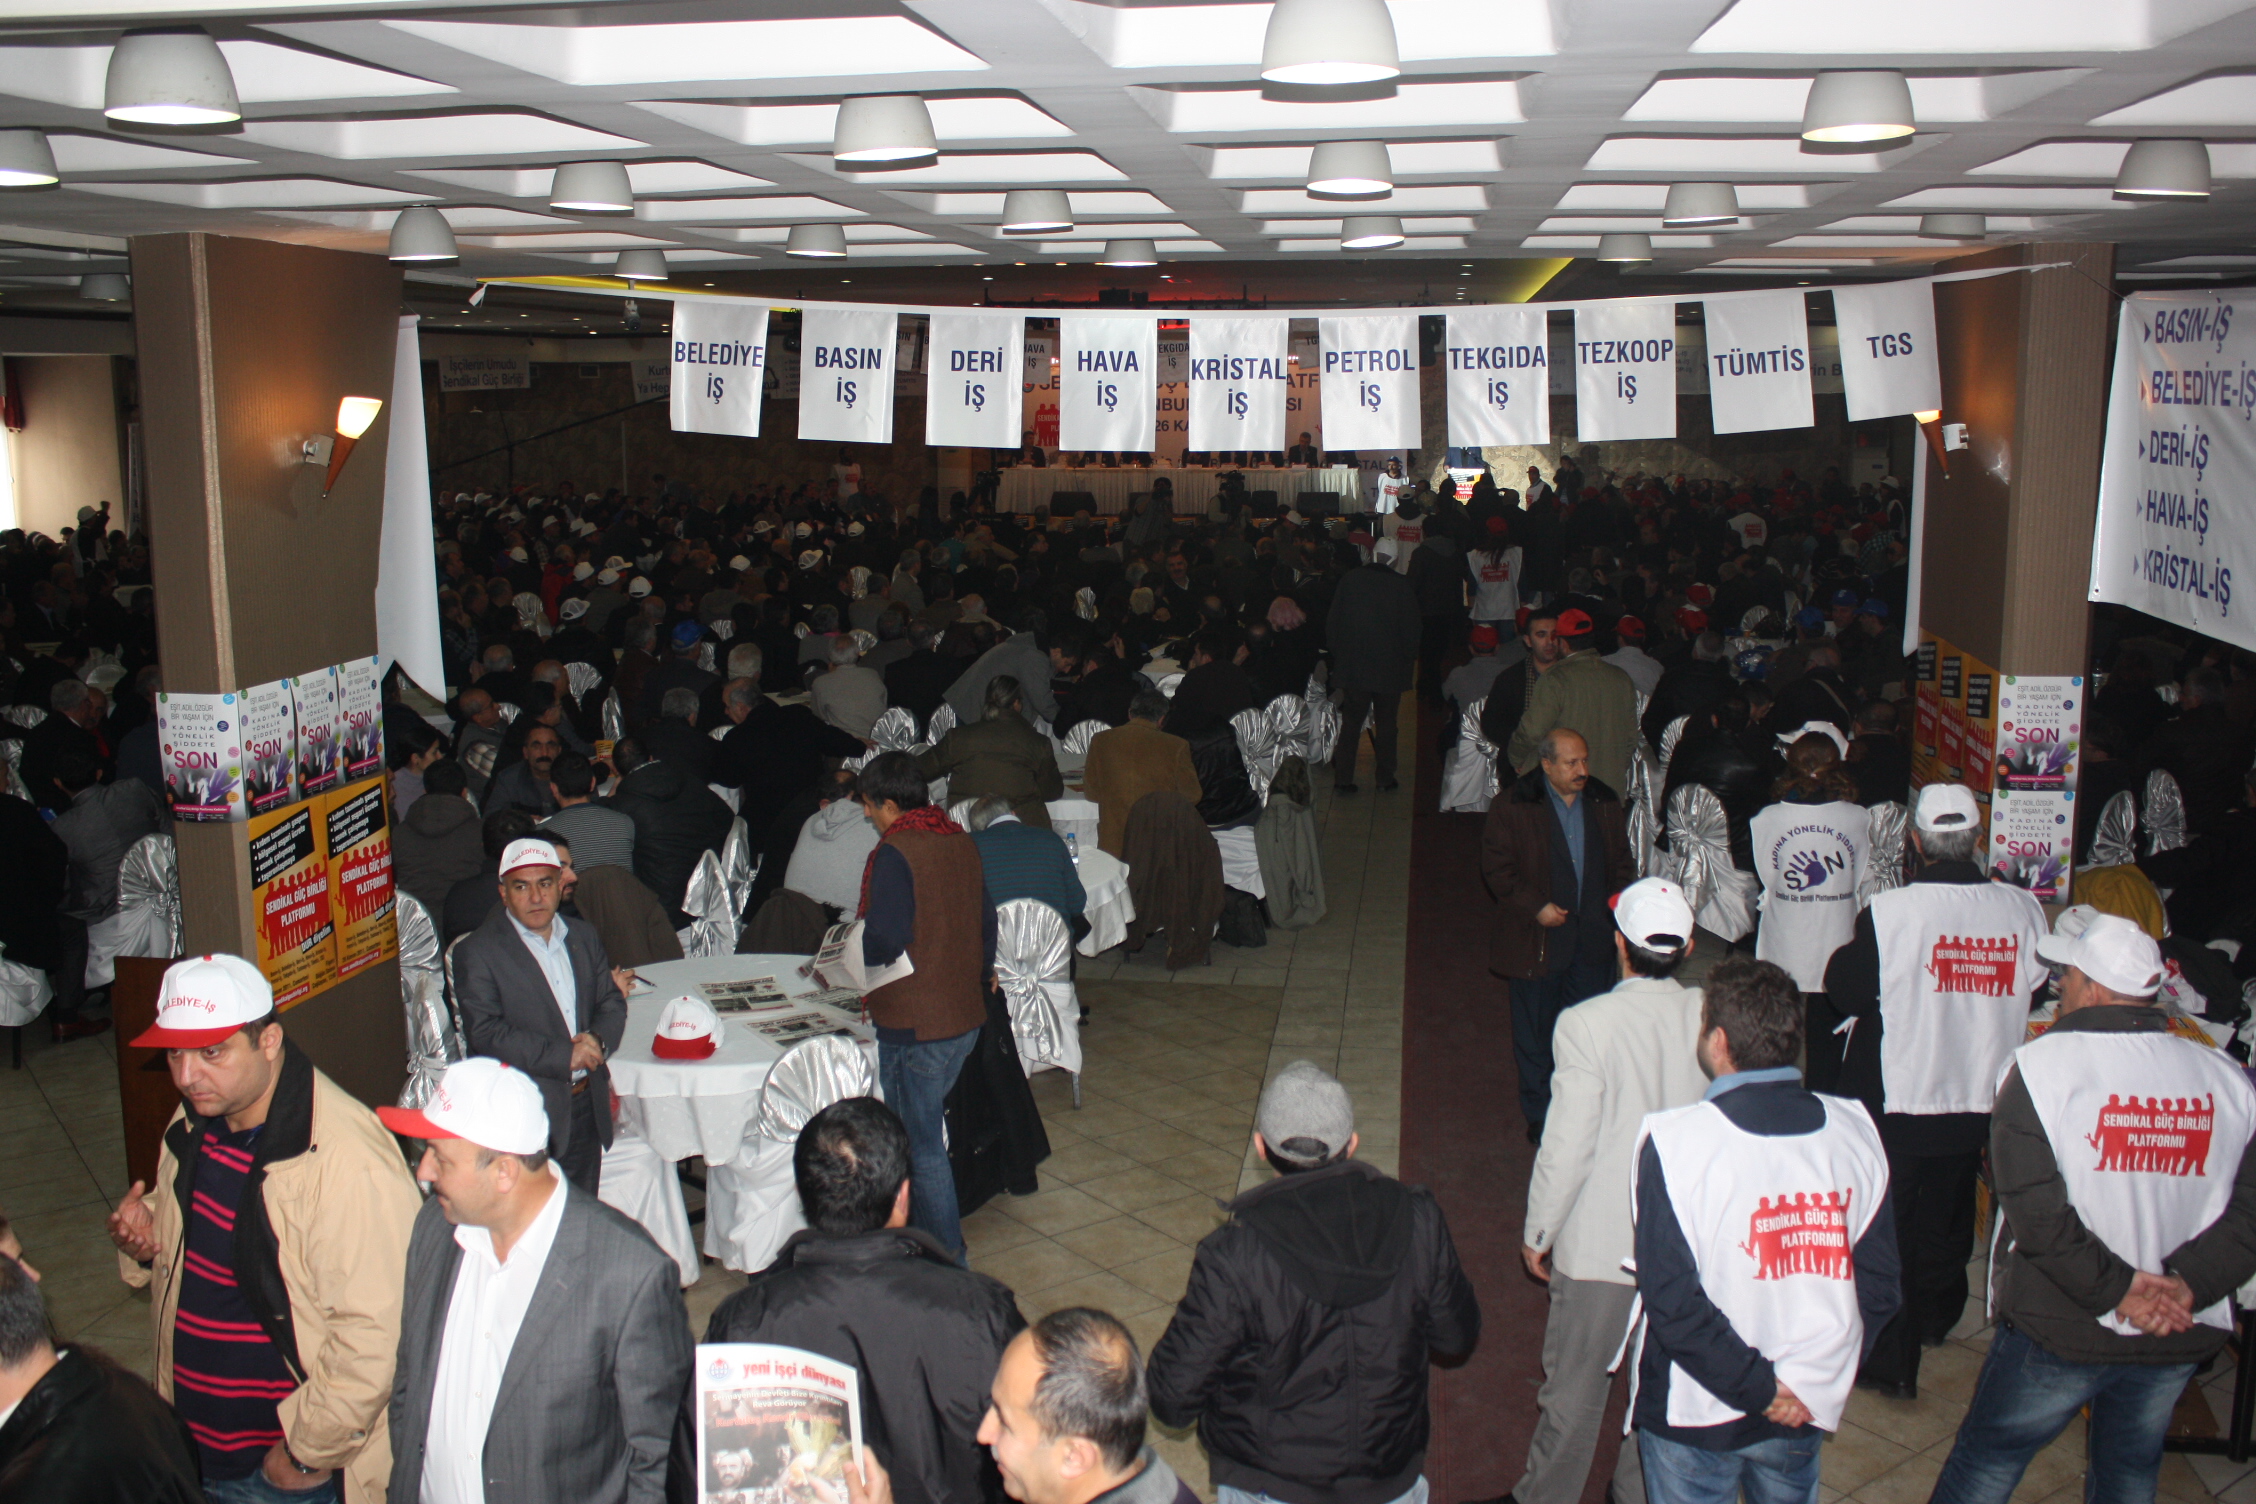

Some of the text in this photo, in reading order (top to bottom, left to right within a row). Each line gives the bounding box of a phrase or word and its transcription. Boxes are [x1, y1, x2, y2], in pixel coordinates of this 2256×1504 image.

[2154, 297, 2233, 353] BASIN-İŞ
[674, 340, 764, 368] BELEDİYE
[815, 346, 881, 370] BASIN
[1448, 344, 1547, 370] TEKGIDA
[1578, 337, 1674, 365] TEZKOOP
[1866, 332, 1914, 359] TGS
[951, 346, 1003, 373] DERİ
[1077, 350, 1139, 373] HAVA
[1191, 353, 1287, 381] KRİSTAL
[1325, 349, 1415, 373] PETROL
[1714, 345, 1805, 376] TÜMTİS
[706, 375, 724, 405] İŞ
[836, 377, 857, 409] İŞ
[964, 379, 985, 410] İŞ
[1097, 380, 1118, 412] İŞ
[1360, 383, 1382, 412] İŞ
[1488, 380, 1509, 410] İŞ
[1617, 374, 1637, 402] İŞ
[2150, 361, 2256, 422] BELEDİYE-İŞ
[1228, 388, 1249, 421] İŞ
[2149, 424, 2209, 482] DERİ-İŞ
[2146, 488, 2209, 546] HAVA-İŞ
[2143, 545, 2231, 618] KRİSTAL-İŞ
[349, 709, 372, 730] SON
[307, 723, 331, 745] SON
[2015, 727, 2059, 743] SON
[174, 751, 218, 769] SON
[253, 737, 282, 761] SON
[1772, 836, 1788, 870] KADINA
[1787, 824, 1834, 838] YÖNELİK
[2007, 840, 2051, 857] SON
[341, 864, 368, 884] SENDİKAL
[368, 858, 380, 873] GÜÇ
[356, 873, 388, 896] PLATFORMU
[266, 876, 327, 915] SENDİKAL GÜÇ BİRLİĞİ
[281, 902, 316, 927] PLATFORMU
[1936, 948, 2015, 964] SENDİKAL GÜÇ BİRLİĞİ
[1952, 963, 1997, 975] PLATFORMU
[2103, 1112, 2211, 1132] SENDİKAL GÜÇ BİRLİĞİ
[2127, 1133, 2186, 1148] PLATFORMU
[1755, 1212, 1802, 1233] SENDİKAL
[1804, 1208, 1828, 1229] GÜÇ
[1781, 1231, 1844, 1249] PLATFORMU
[742, 1360, 846, 1390] yeni işçi dünyası
